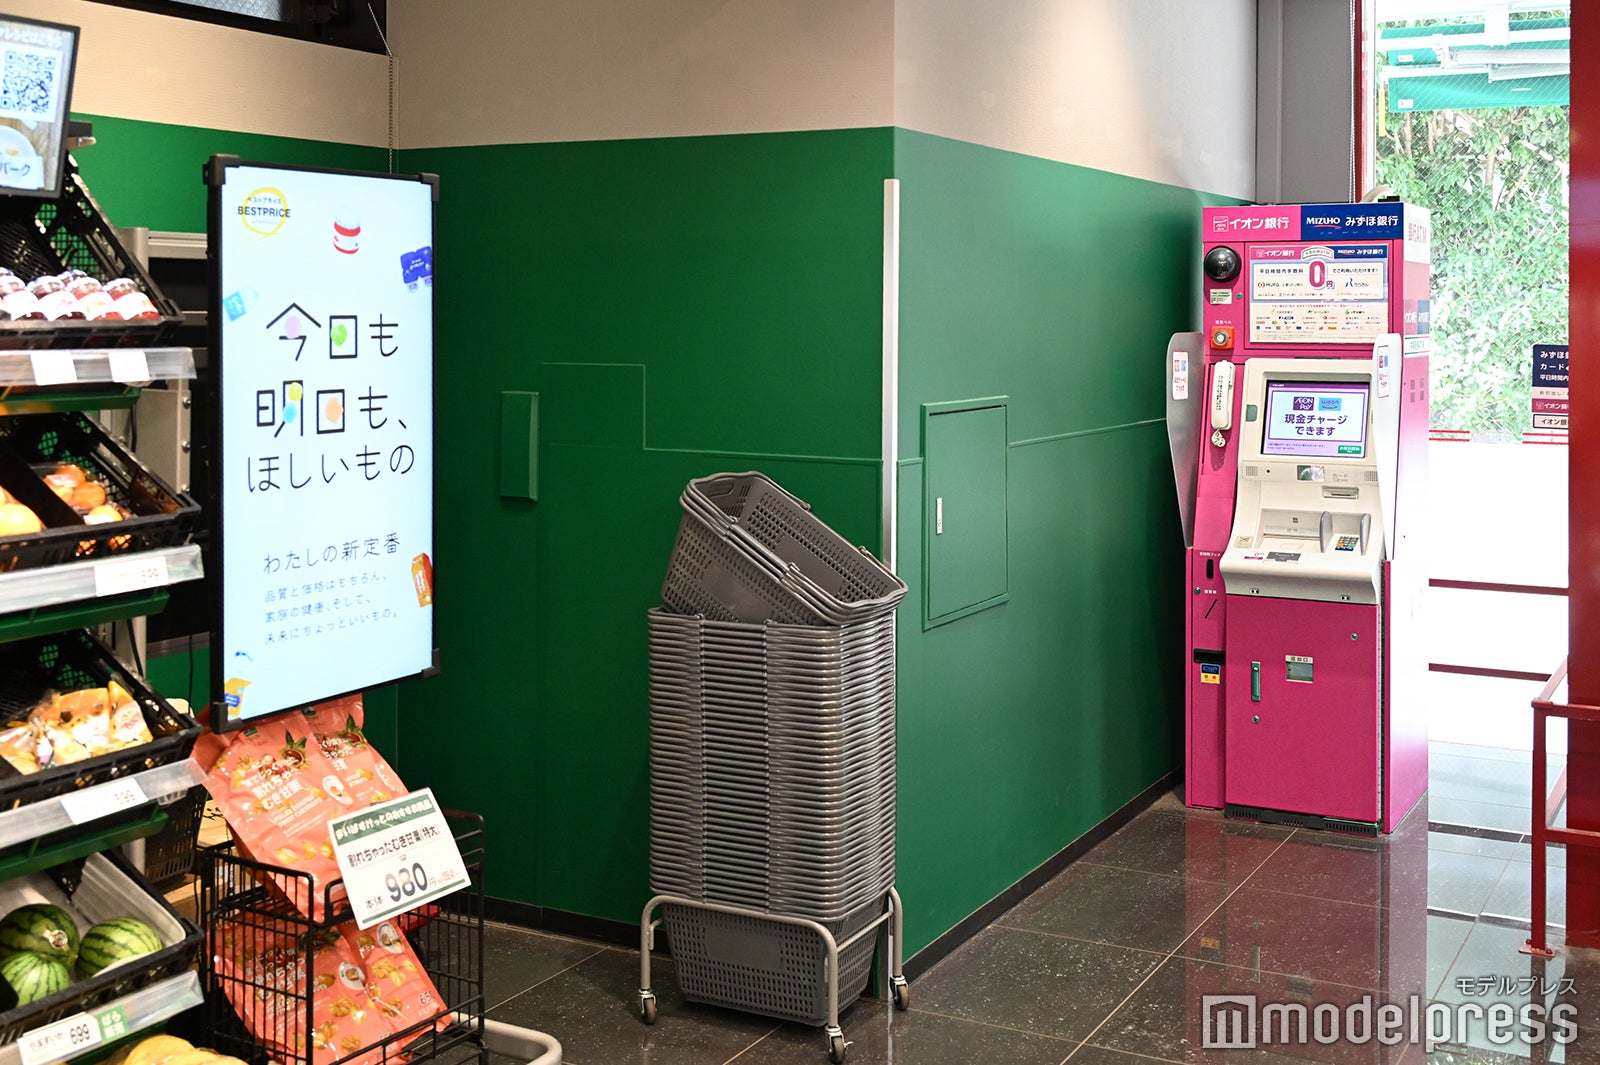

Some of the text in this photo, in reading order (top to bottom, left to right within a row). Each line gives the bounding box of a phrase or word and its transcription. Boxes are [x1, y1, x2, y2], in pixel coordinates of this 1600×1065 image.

[237, 206, 291, 218] BESTPRICE
[1229, 217, 1290, 230] イオン銀行
[1306, 215, 1399, 227] MIZUHO みずほ銀行
[266, 302, 399, 361] 今日も
[1284, 413, 1349, 425] 現金チャージ
[1295, 426, 1336, 437] できます
[248, 444, 415, 493] ほしいもの
[263, 532, 401, 574] わたしの新定番
[385, 862, 429, 902] 980
[70, 1023, 91, 1045] 699
